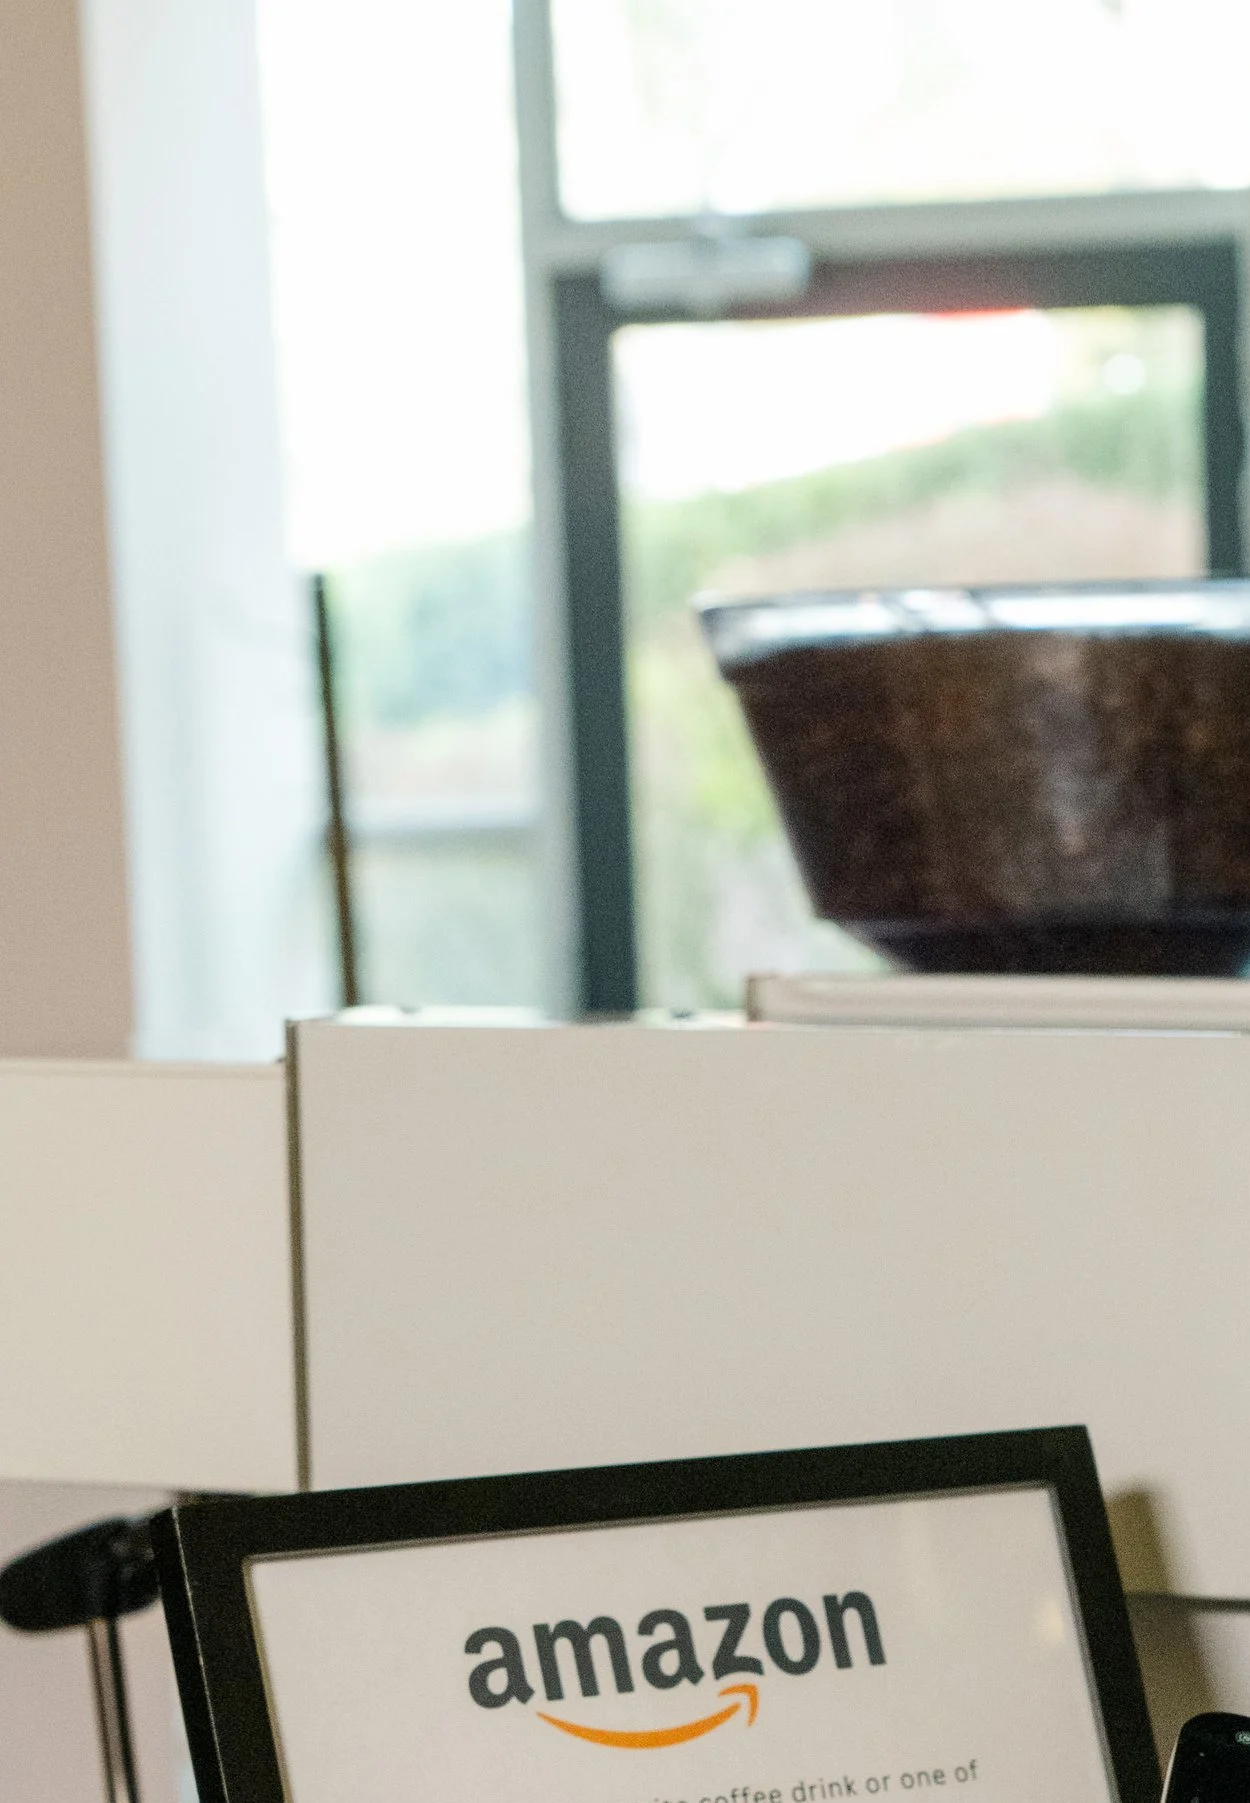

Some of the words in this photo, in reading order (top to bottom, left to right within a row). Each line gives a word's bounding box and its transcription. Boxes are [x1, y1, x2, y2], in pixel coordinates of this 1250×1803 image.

[463, 1588, 888, 1709] amazon
[792, 1776, 857, 1803] drink
[866, 1774, 891, 1795] or
[900, 1769, 945, 1789] one
[955, 1758, 979, 1784] of
